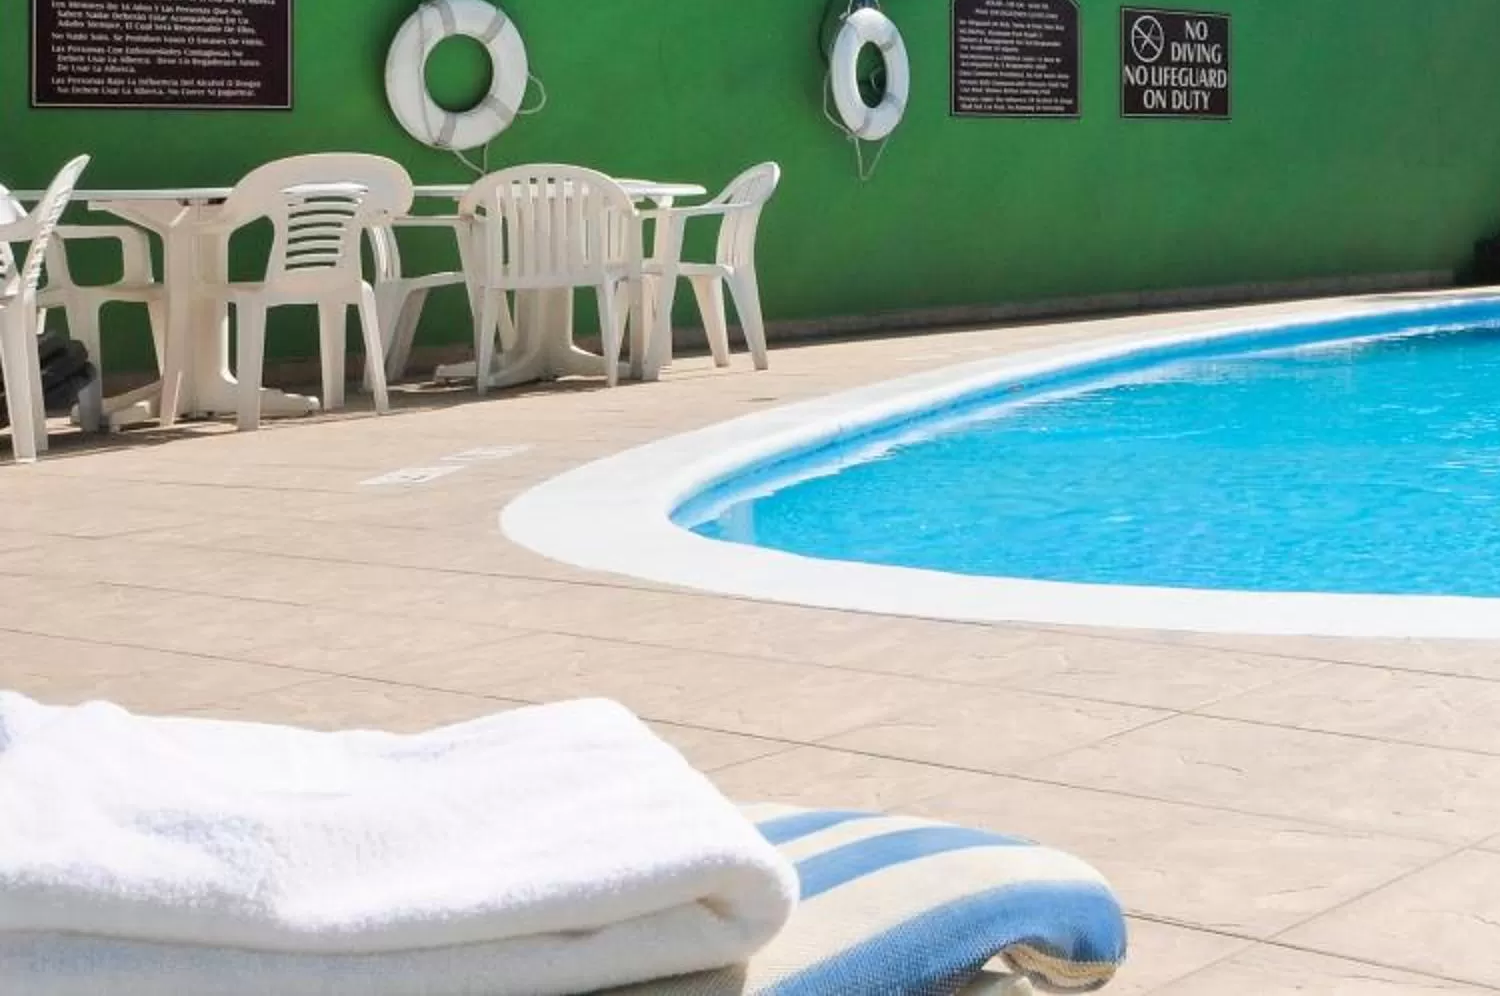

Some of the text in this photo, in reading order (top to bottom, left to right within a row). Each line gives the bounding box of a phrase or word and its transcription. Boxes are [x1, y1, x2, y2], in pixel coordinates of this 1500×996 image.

[1185, 19, 1209, 42] NO
[1171, 41, 1222, 65] DIVING
[1124, 64, 1228, 89] NO LIFEGUARD
[1143, 88, 1212, 111] ON DUTY
